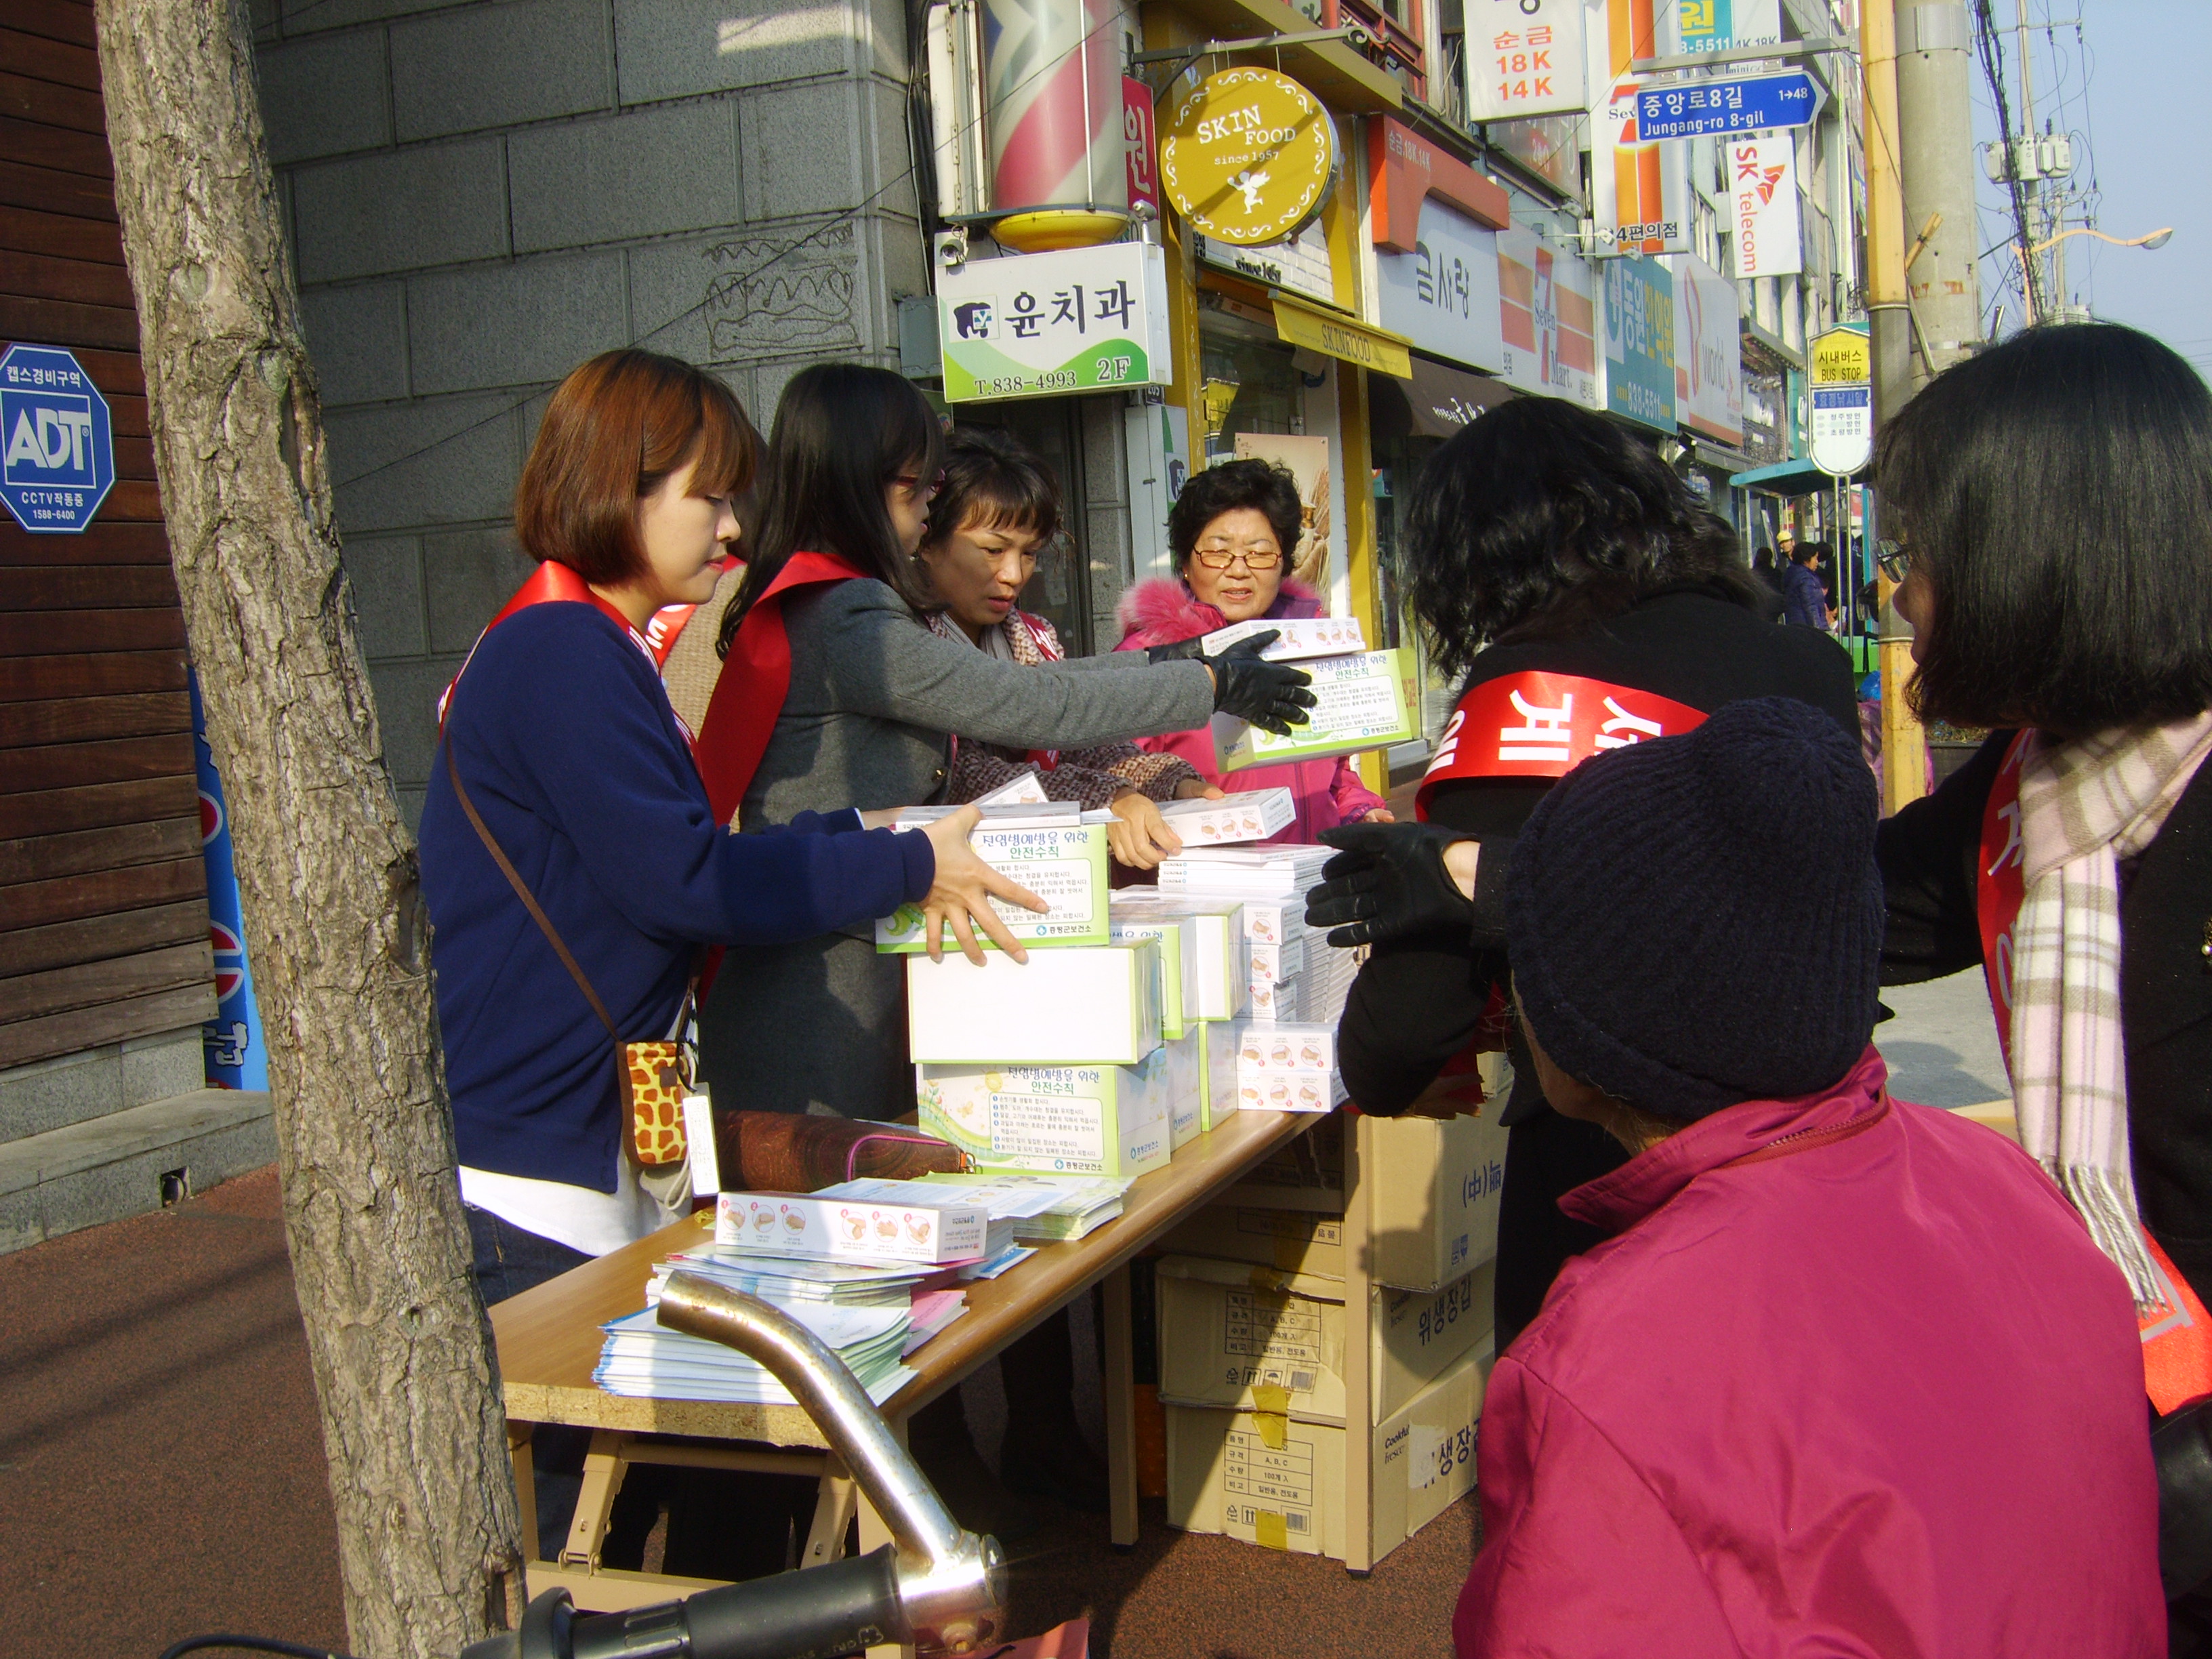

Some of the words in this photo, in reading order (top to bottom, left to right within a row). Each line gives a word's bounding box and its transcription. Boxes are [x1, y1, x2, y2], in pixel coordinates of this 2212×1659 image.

[1493, 26, 1553, 50] 순금
[1496, 50, 1552, 75] 18K
[1498, 77, 1553, 101] 14K
[1643, 85, 1742, 119] 중앙로8길
[1197, 104, 1261, 144] SKIN
[1645, 117, 1724, 137] Jungang-ro
[1730, 110, 1765, 130] 8-gil
[1245, 127, 1296, 145] FOOD
[1214, 155, 1248, 165] since
[1252, 150, 1279, 162] 1957
[1736, 146, 1759, 182] SK
[1738, 190, 1758, 272] telecom
[1004, 280, 1136, 338] 윤치과
[1322, 323, 1370, 363] SKINFOOD
[1097, 356, 1130, 380] 2F
[1818, 350, 1862, 364] 시내버스
[7, 365, 81, 388] 캡스경비구역
[975, 371, 1076, 396] T.838-4993
[1822, 369, 1836, 382] BUS
[1841, 367, 1861, 380] STOP
[5, 407, 90, 470] ADT
[21, 491, 84, 507] CCTV작동중
[33, 509, 75, 520] 1588-6400
[1336, 668, 1369, 679] 안전수칙
[983, 832, 1058, 846] 전염병예방을
[1064, 831, 1088, 843] 위한
[1010, 846, 1059, 859] 안전수칙
[1050, 925, 1091, 934] 증평군보건소
[1008, 1067, 1073, 1082] 전염병예방을
[1078, 1070, 1100, 1083] 위한
[1031, 1081, 1074, 1094] 안전수칙
[1066, 1162, 1103, 1171] 증평군보건소
[1419, 1273, 1471, 1347] 위생장갑
